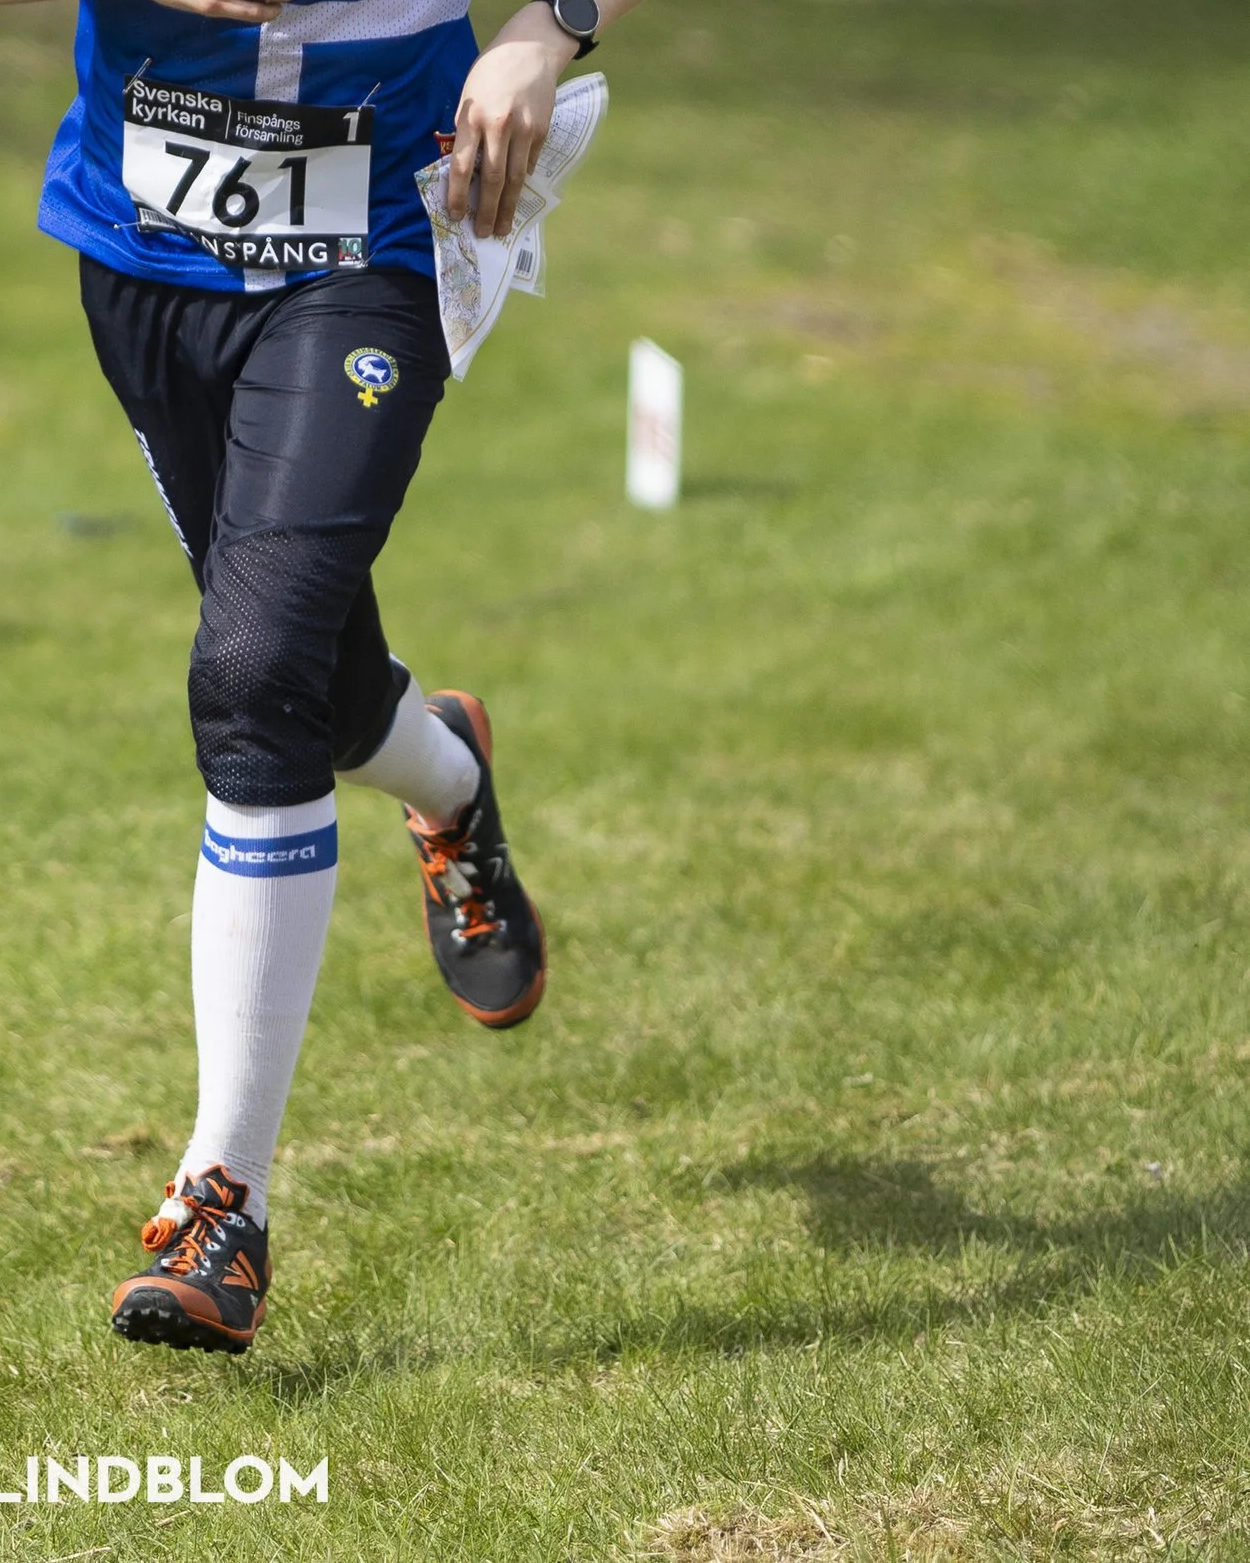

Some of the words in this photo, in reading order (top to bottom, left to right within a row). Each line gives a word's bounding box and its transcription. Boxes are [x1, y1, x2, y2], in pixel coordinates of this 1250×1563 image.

[133, 80, 223, 113] Svenska
[132, 97, 206, 130] kyrkan
[237, 111, 301, 132] Finspångs
[343, 111, 360, 142] 1
[235, 123, 303, 146] församling
[165, 140, 308, 228] 761
